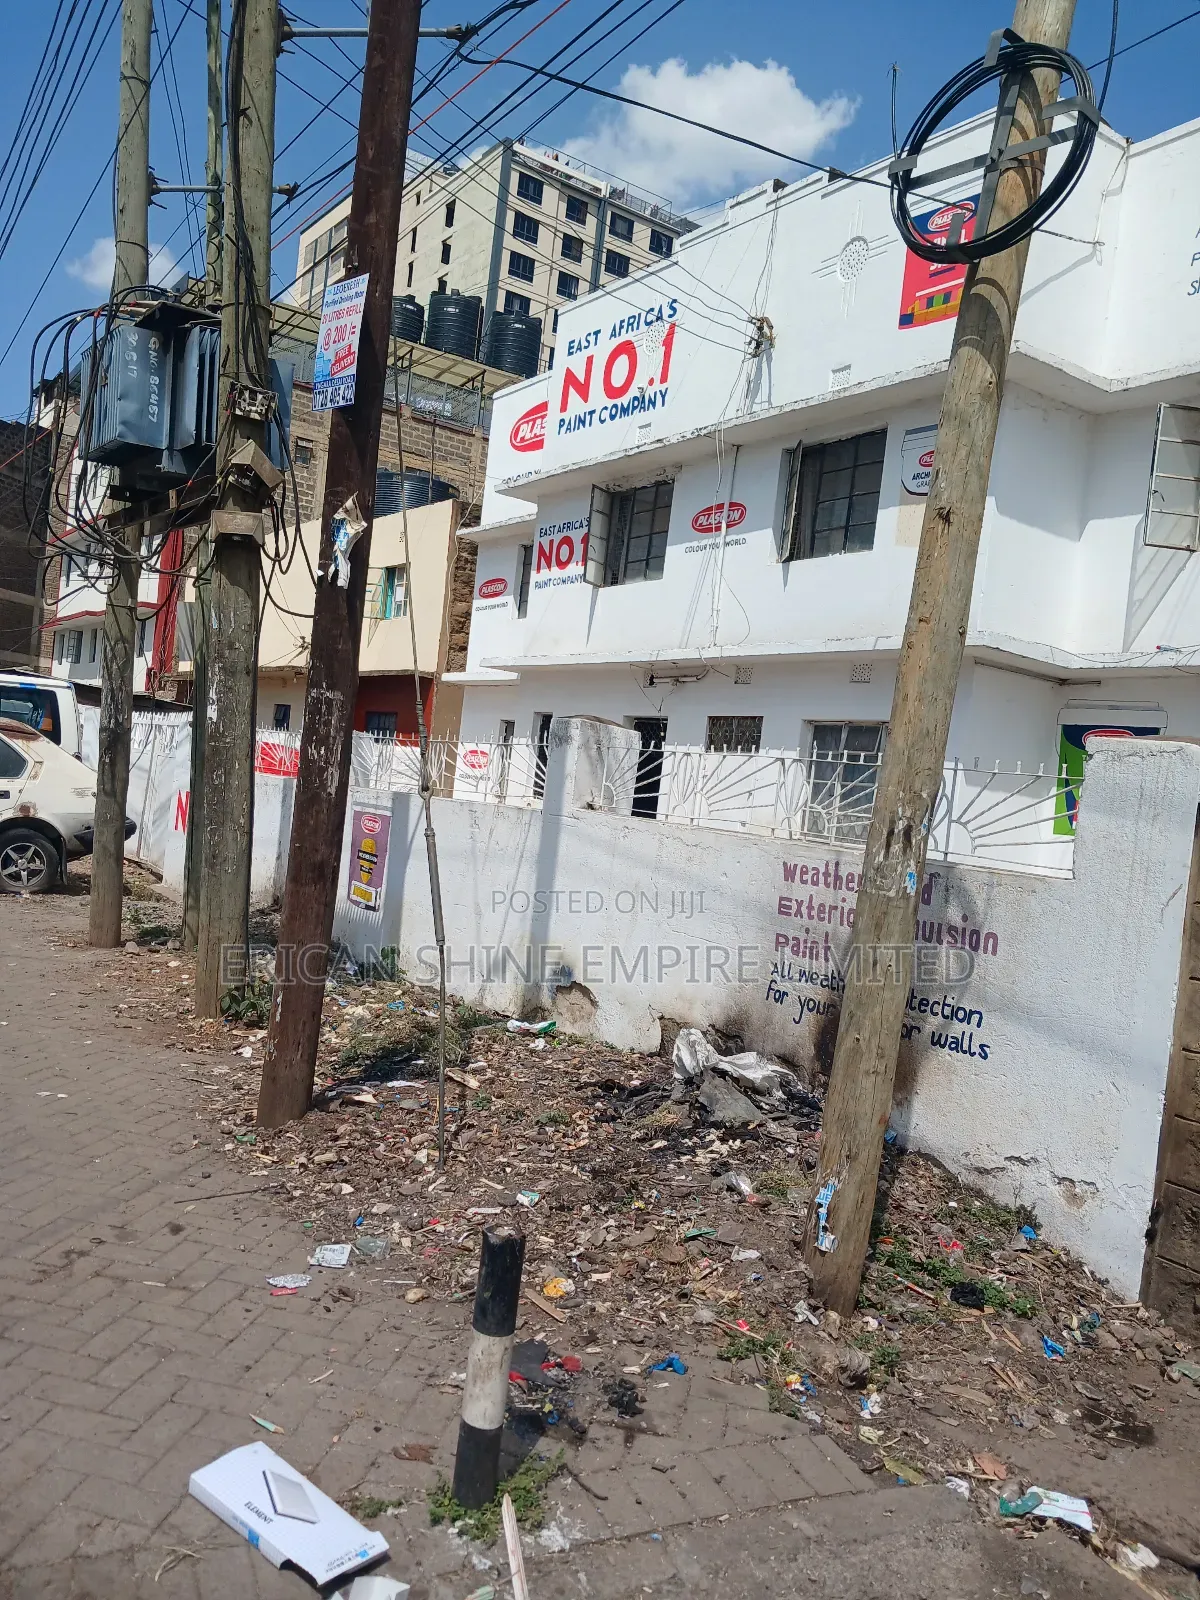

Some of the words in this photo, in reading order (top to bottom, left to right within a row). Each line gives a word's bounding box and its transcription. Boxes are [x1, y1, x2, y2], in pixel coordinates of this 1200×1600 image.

[328, 308, 345, 323] LITRES
[345, 303, 362, 317] REFILL
[323, 328, 331, 351] @
[332, 324, 348, 344] 200
[567, 328, 602, 357] EAST
[609, 298, 678, 340] AFRICA'S
[332, 352, 356, 374] DELIVERY
[337, 345, 350, 360] FREE
[559, 321, 677, 414] NO.1
[557, 408, 597, 436] PAINT
[598, 387, 669, 425] COMPANY
[539, 526, 556, 538] EAST
[557, 516, 589, 535] AFRICA'S
[536, 532, 589, 575] NO.1
[685, 543, 707, 554] COLOUR
[708, 541, 720, 551] YOU
[725, 537, 747, 548] WORLD
[482, 582, 506, 594] PLASCON
[534, 578, 552, 590] PAINT
[552, 573, 584, 588] COMPANY
[777, 894, 856, 929] Exterio
[771, 962, 793, 981] All
[799, 968, 845, 994] weath
[905, 987, 983, 1028] tection
[793, 994, 837, 1025] your
[931, 1029, 991, 1061] walls
[244, 1500, 274, 1525] ELEMENT
